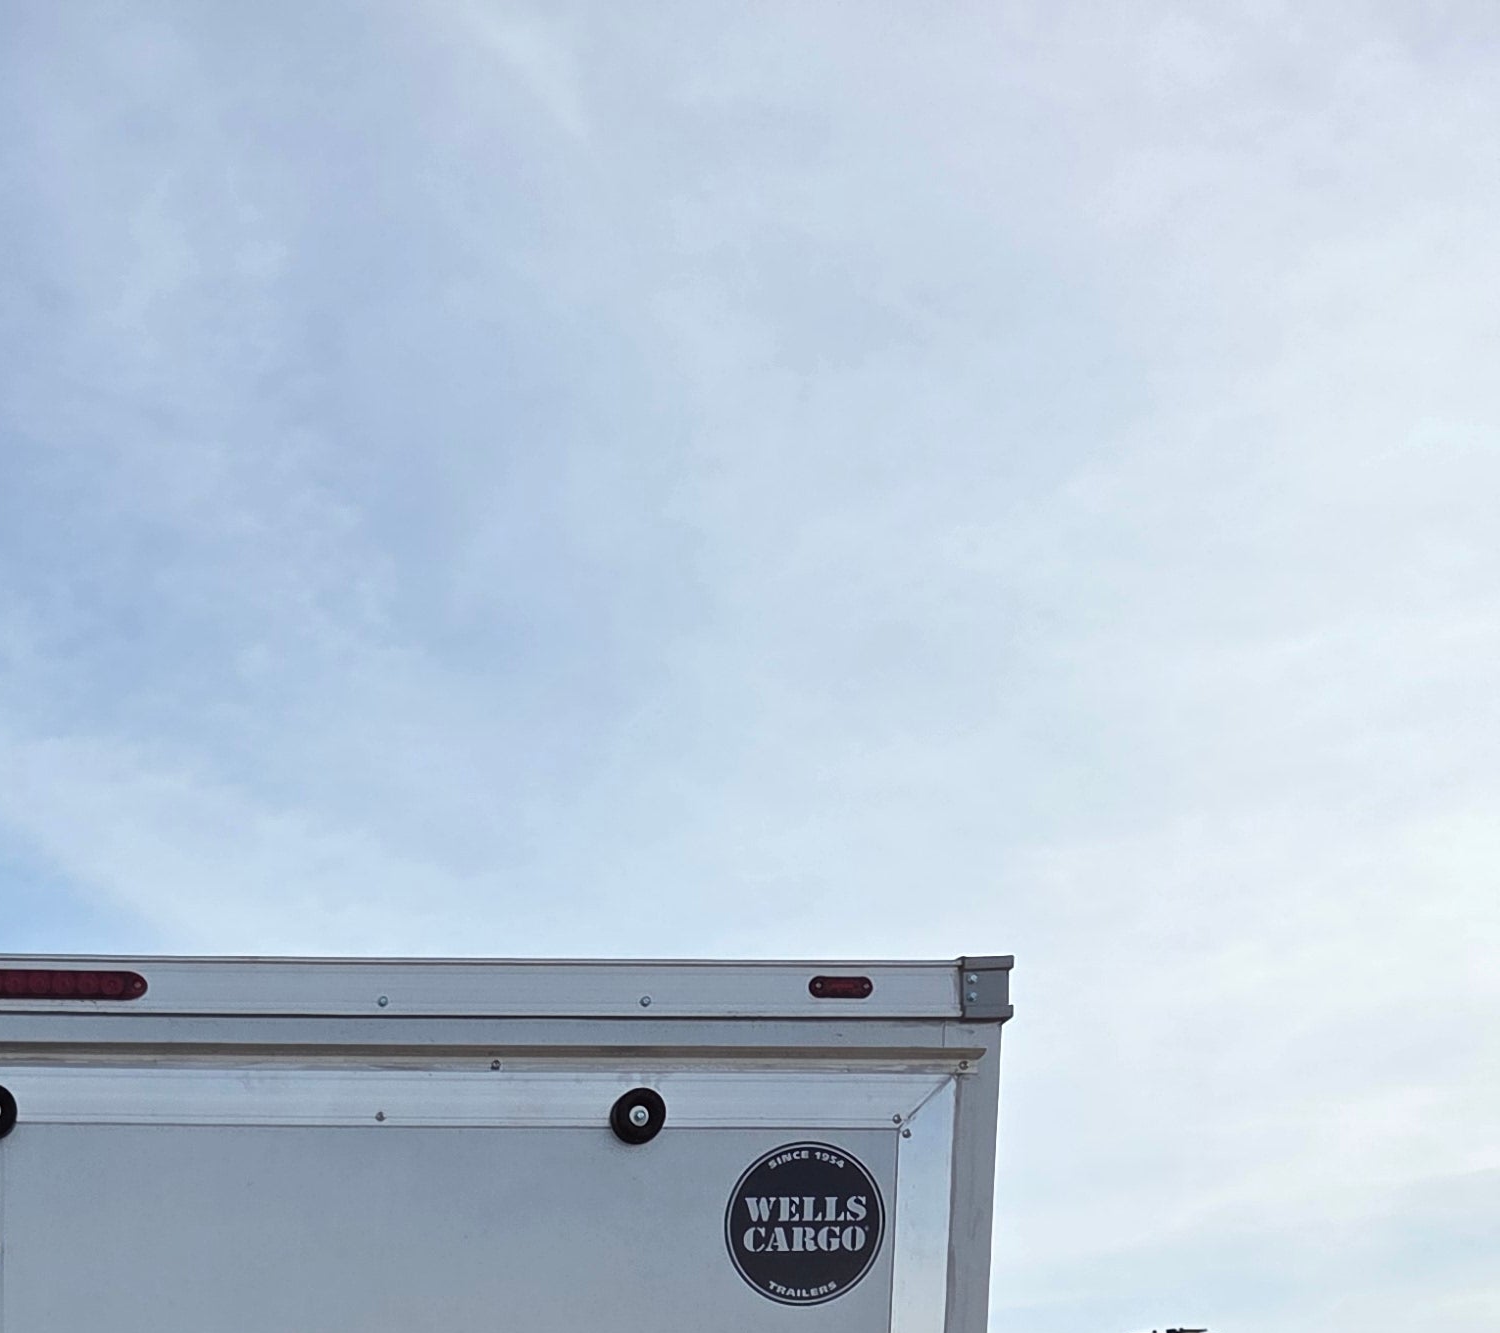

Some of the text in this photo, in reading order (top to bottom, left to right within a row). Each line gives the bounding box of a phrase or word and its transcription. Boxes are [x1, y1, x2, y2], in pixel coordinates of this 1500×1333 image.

[768, 1150, 845, 1169] SINCE 1954
[744, 1195, 868, 1223] WELLS
[743, 1225, 867, 1253] CARGO
[768, 1280, 837, 1298] TRAILERS
